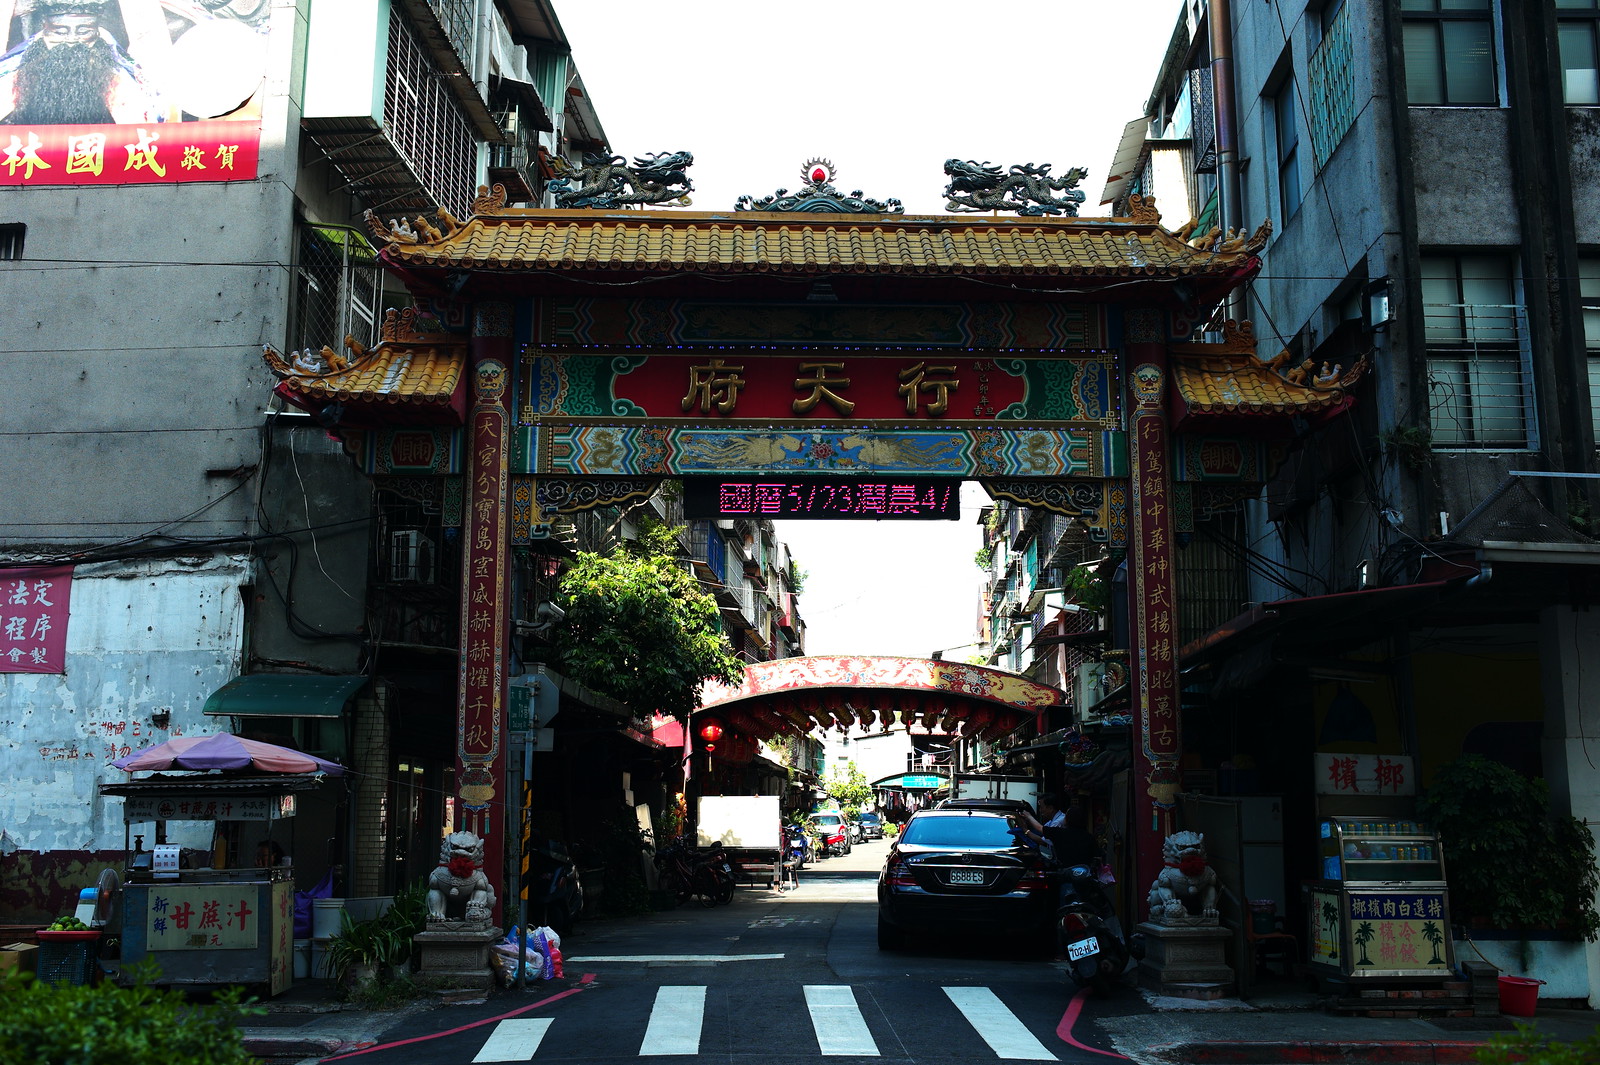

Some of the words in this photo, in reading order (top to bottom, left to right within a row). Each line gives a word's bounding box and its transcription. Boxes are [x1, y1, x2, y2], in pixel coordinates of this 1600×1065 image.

[1, 128, 167, 180] 林國成
[180, 143, 240, 172] 敬賀
[0, 580, 54, 607] 法定
[0, 613, 52, 642] 程序
[0, 647, 48, 664] 會製
[1328, 757, 1404, 793] 檳榔
[178, 801, 233, 817] 甘蔗原汁
[152, 895, 170, 936] 新鮮
[169, 900, 253, 931] 甘蔗汁
